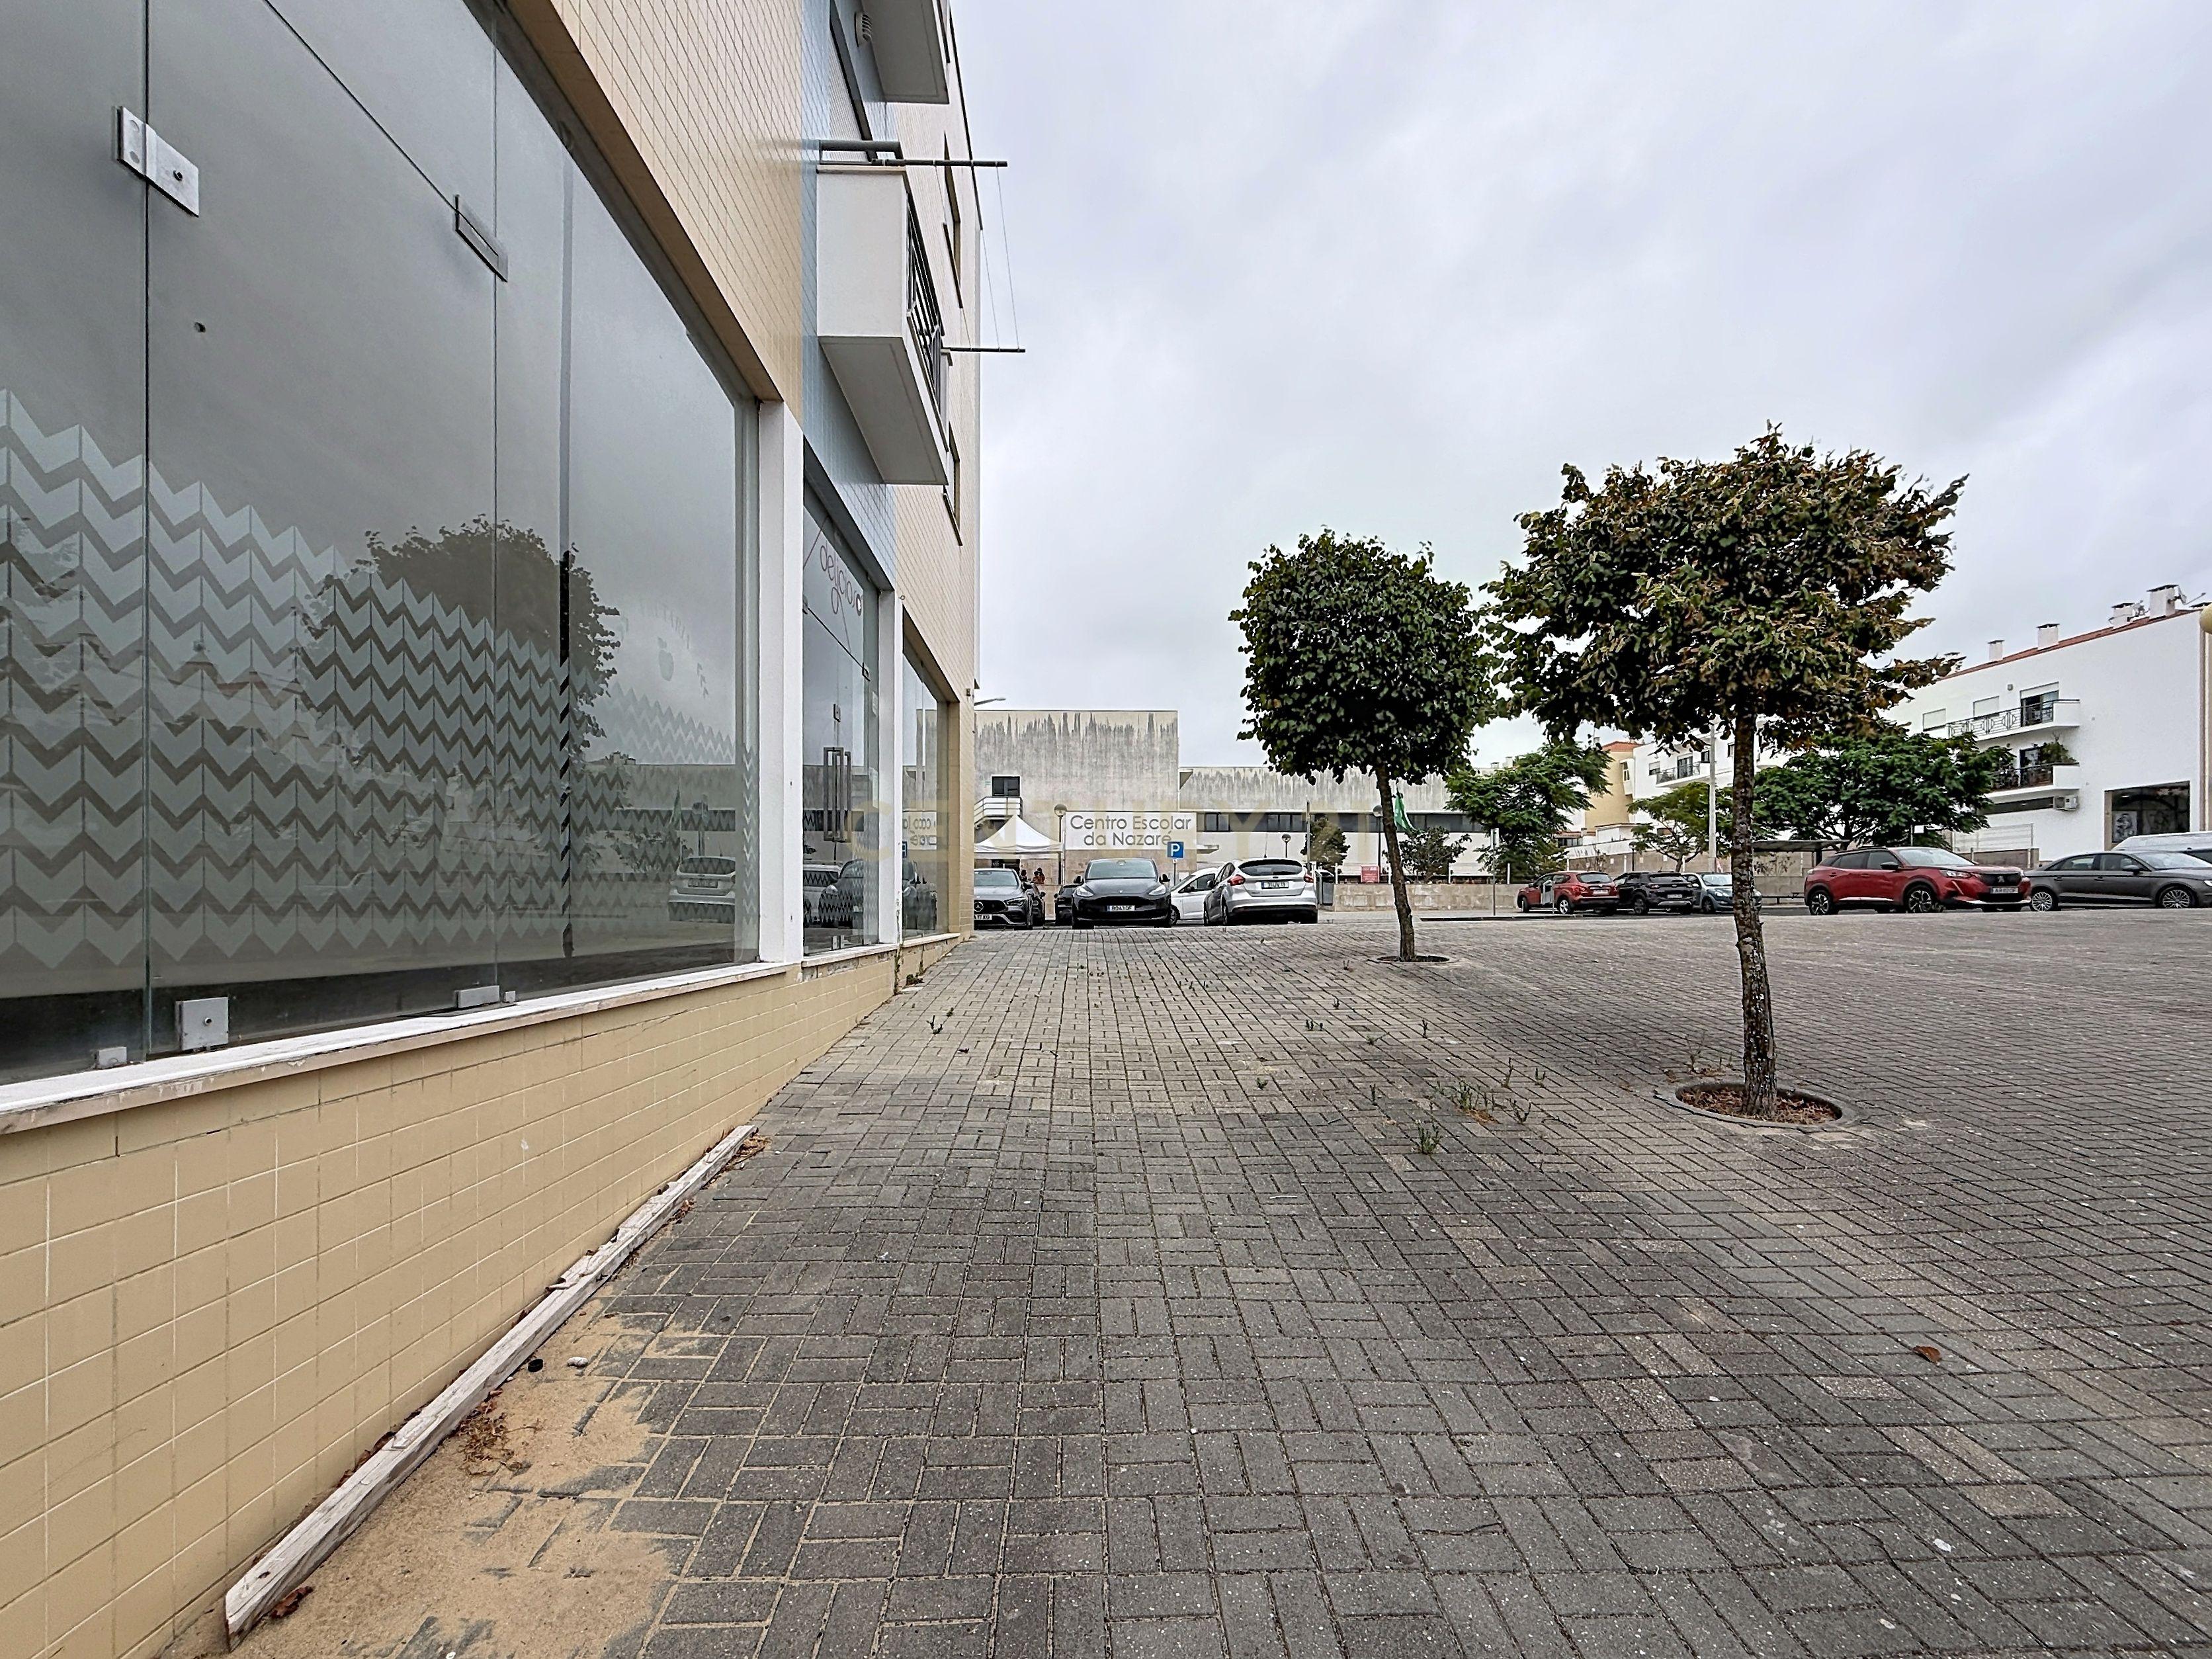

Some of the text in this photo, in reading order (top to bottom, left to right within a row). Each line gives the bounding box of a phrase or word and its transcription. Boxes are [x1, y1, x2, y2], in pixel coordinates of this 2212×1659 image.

[1070, 815, 1192, 830] Centro Escolar
[1083, 830, 1172, 846] da Nazaré
[1170, 843, 1181, 857] P
